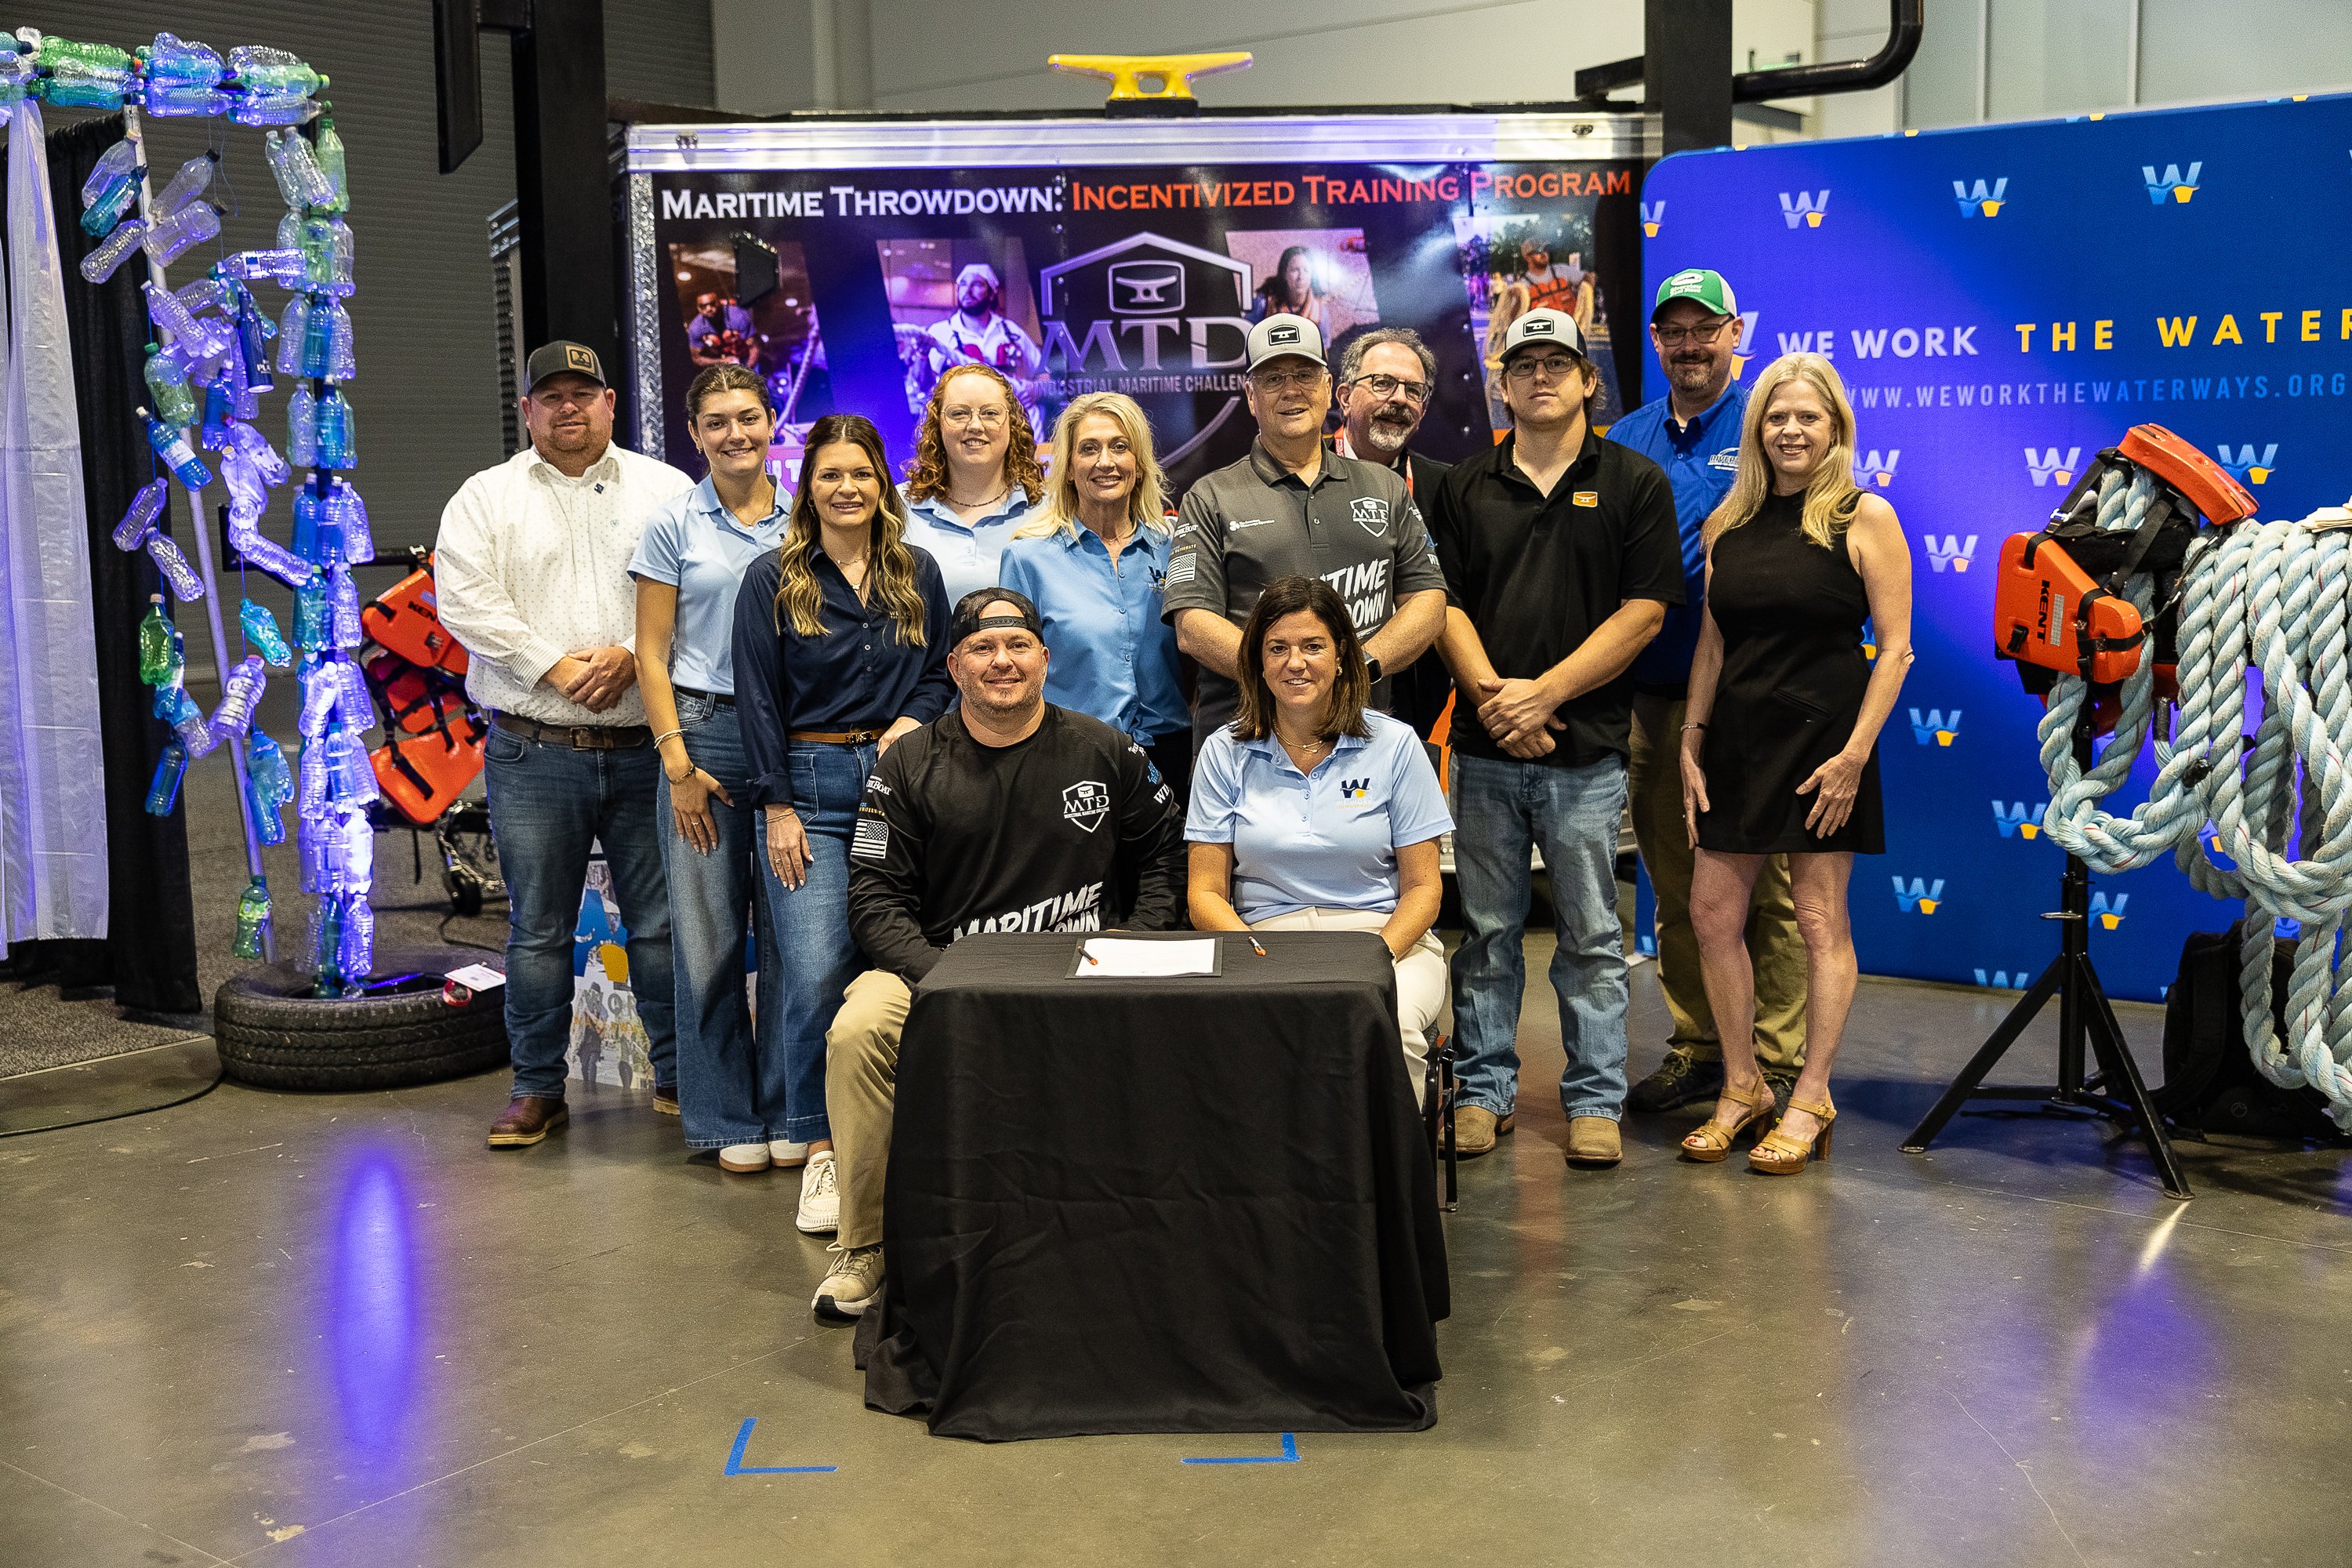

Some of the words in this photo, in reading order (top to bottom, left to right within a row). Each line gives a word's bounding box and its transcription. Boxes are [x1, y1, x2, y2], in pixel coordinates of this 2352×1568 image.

[662, 189, 824, 220] MARITIME
[829, 185, 1062, 216] THROWDOWN:
[1073, 180, 1295, 211] INCENTIVIZED
[1302, 175, 1461, 205] TRAINING
[1470, 170, 1631, 199] PROGRAM
[1040, 317, 1253, 373] MTD
[1777, 330, 1835, 360] WE
[1851, 325, 1979, 359] WORK
[2016, 320, 2113, 353] THE
[1118, 376, 1182, 394] MARITIME
[2037, 579, 2051, 645] KENT
[1063, 795, 1110, 815] MTD
